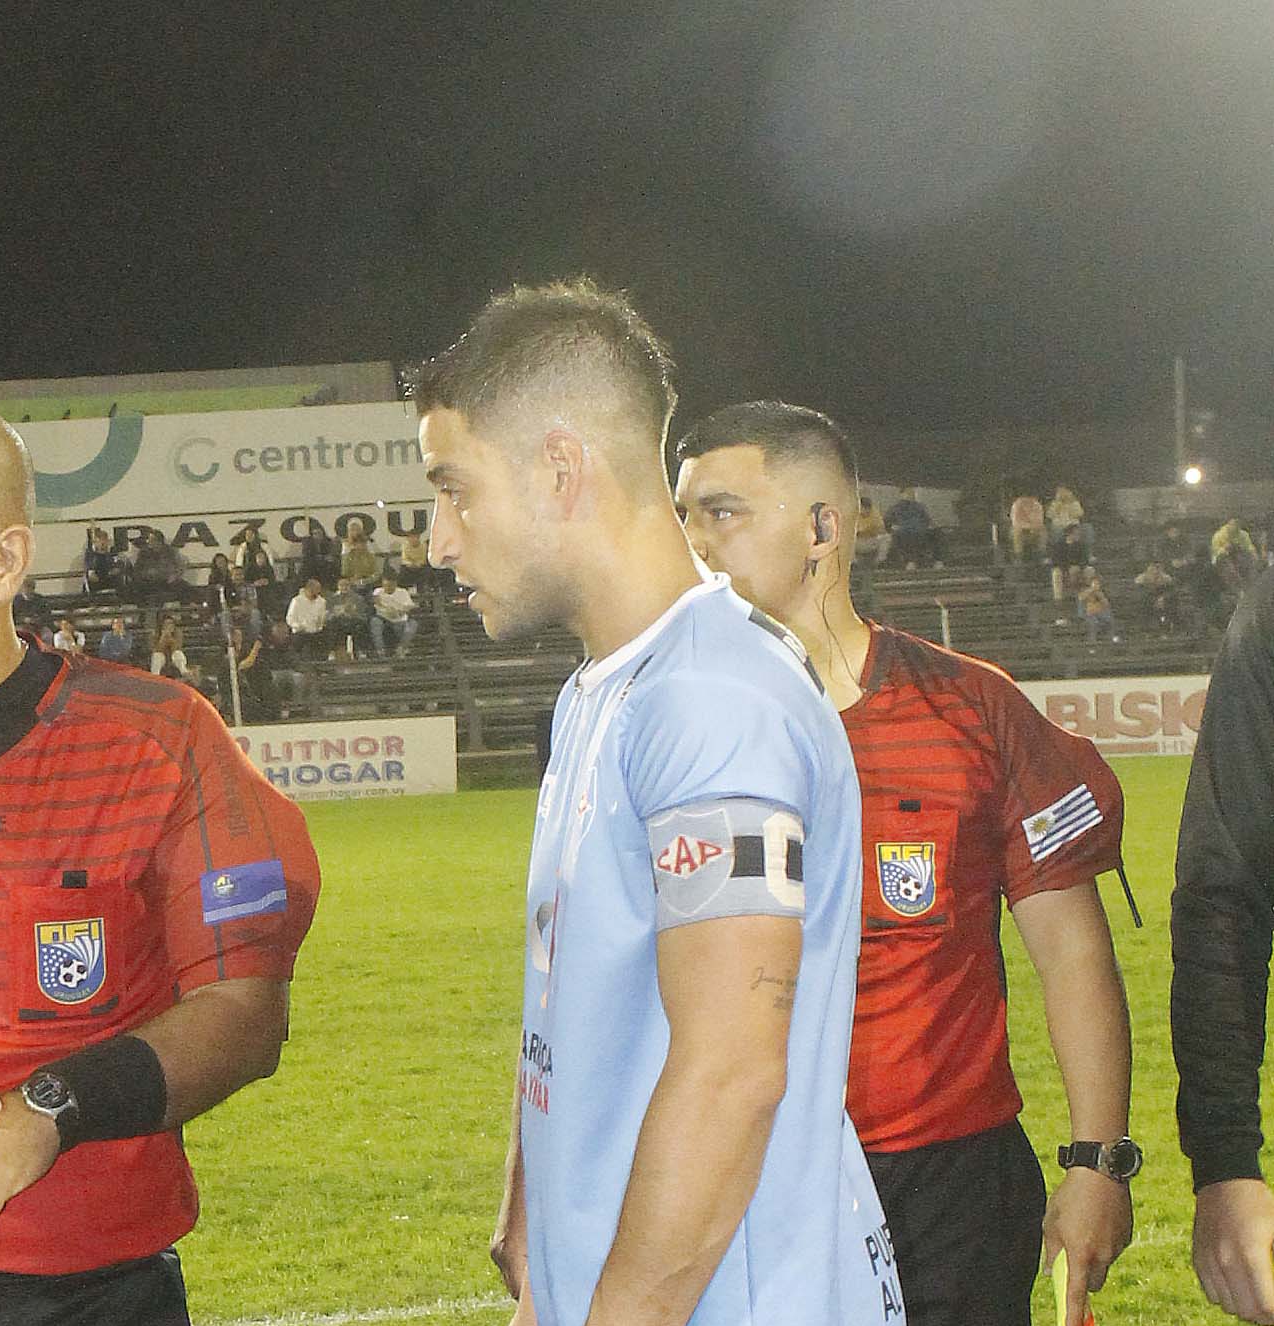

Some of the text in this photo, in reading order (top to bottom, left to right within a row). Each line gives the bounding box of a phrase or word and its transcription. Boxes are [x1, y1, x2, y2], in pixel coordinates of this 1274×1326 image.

[261, 735, 405, 763] LITNOR
[264, 760, 405, 787] HOGAR
[657, 834, 724, 875] CAP
